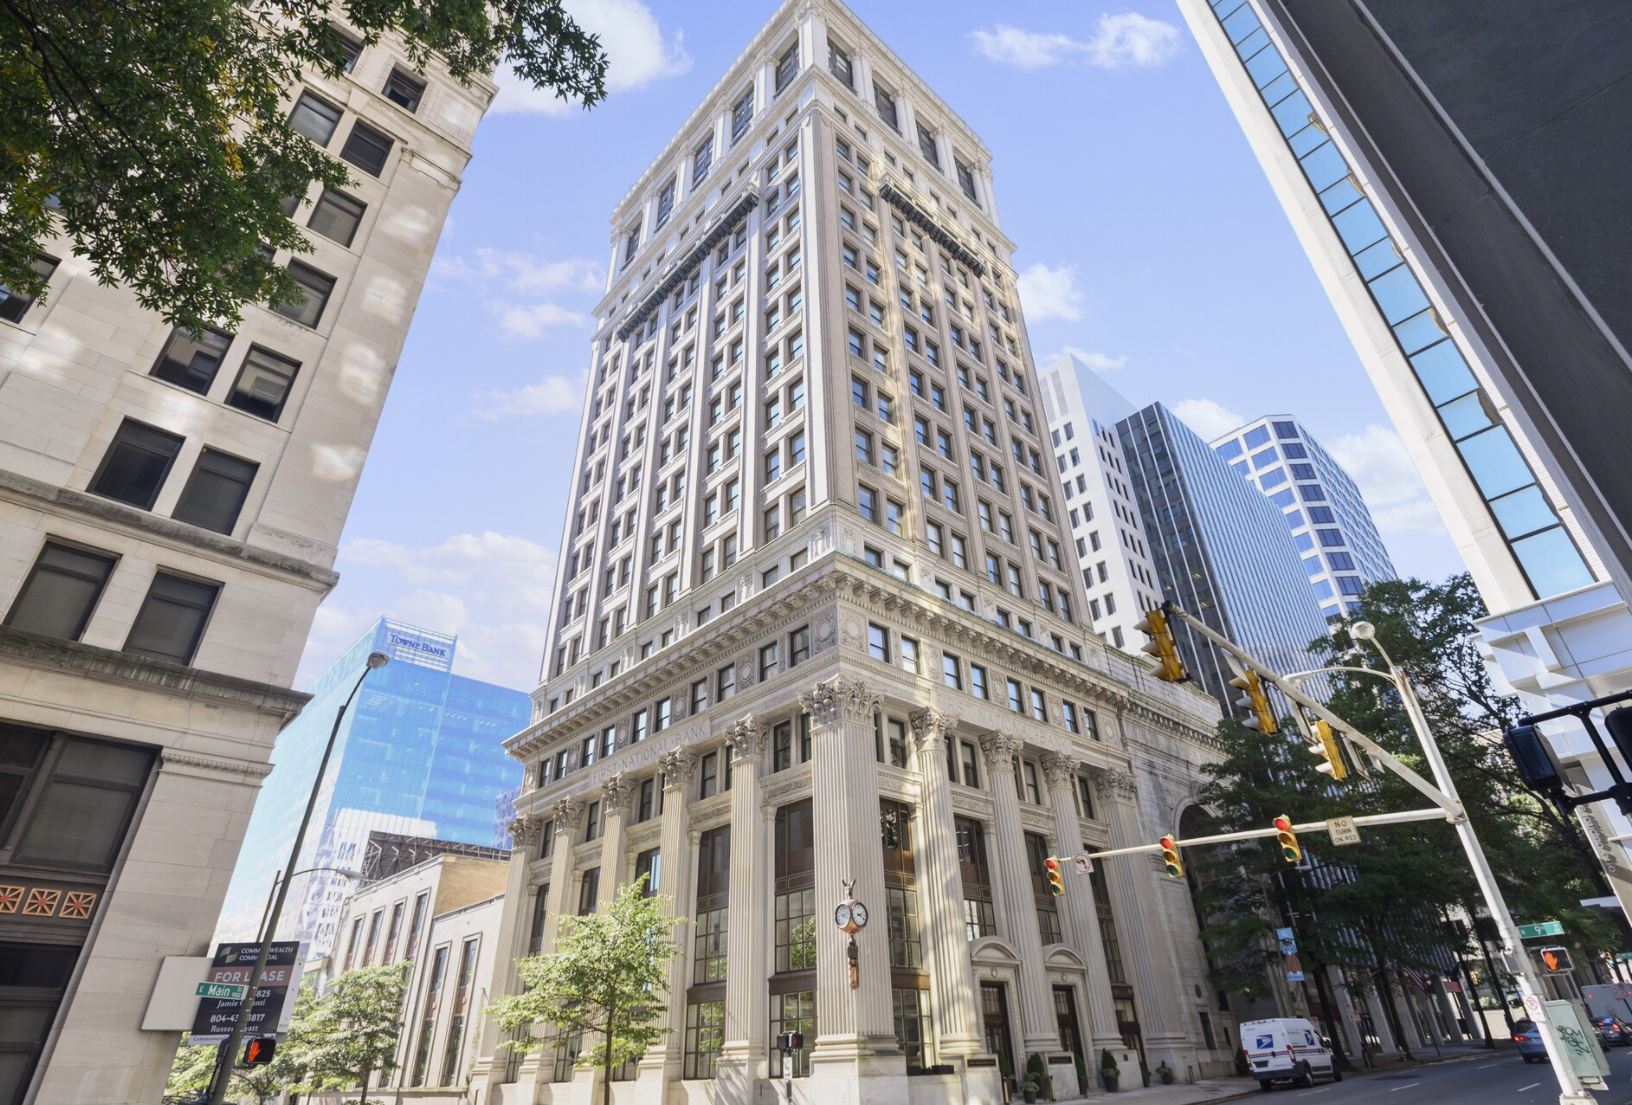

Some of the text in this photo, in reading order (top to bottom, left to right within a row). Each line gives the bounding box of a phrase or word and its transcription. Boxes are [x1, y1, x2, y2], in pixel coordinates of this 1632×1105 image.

[390, 634, 446, 656] TOWNE BANK
[622, 740, 667, 769] NATIONAL
[675, 721, 705, 744] BANK
[1334, 820, 1346, 828] NO
[215, 970, 285, 983] FOR LASE
[199, 985, 204, 993] E
[208, 984, 230, 997] Main
[217, 1000, 238, 1009] Jamie
